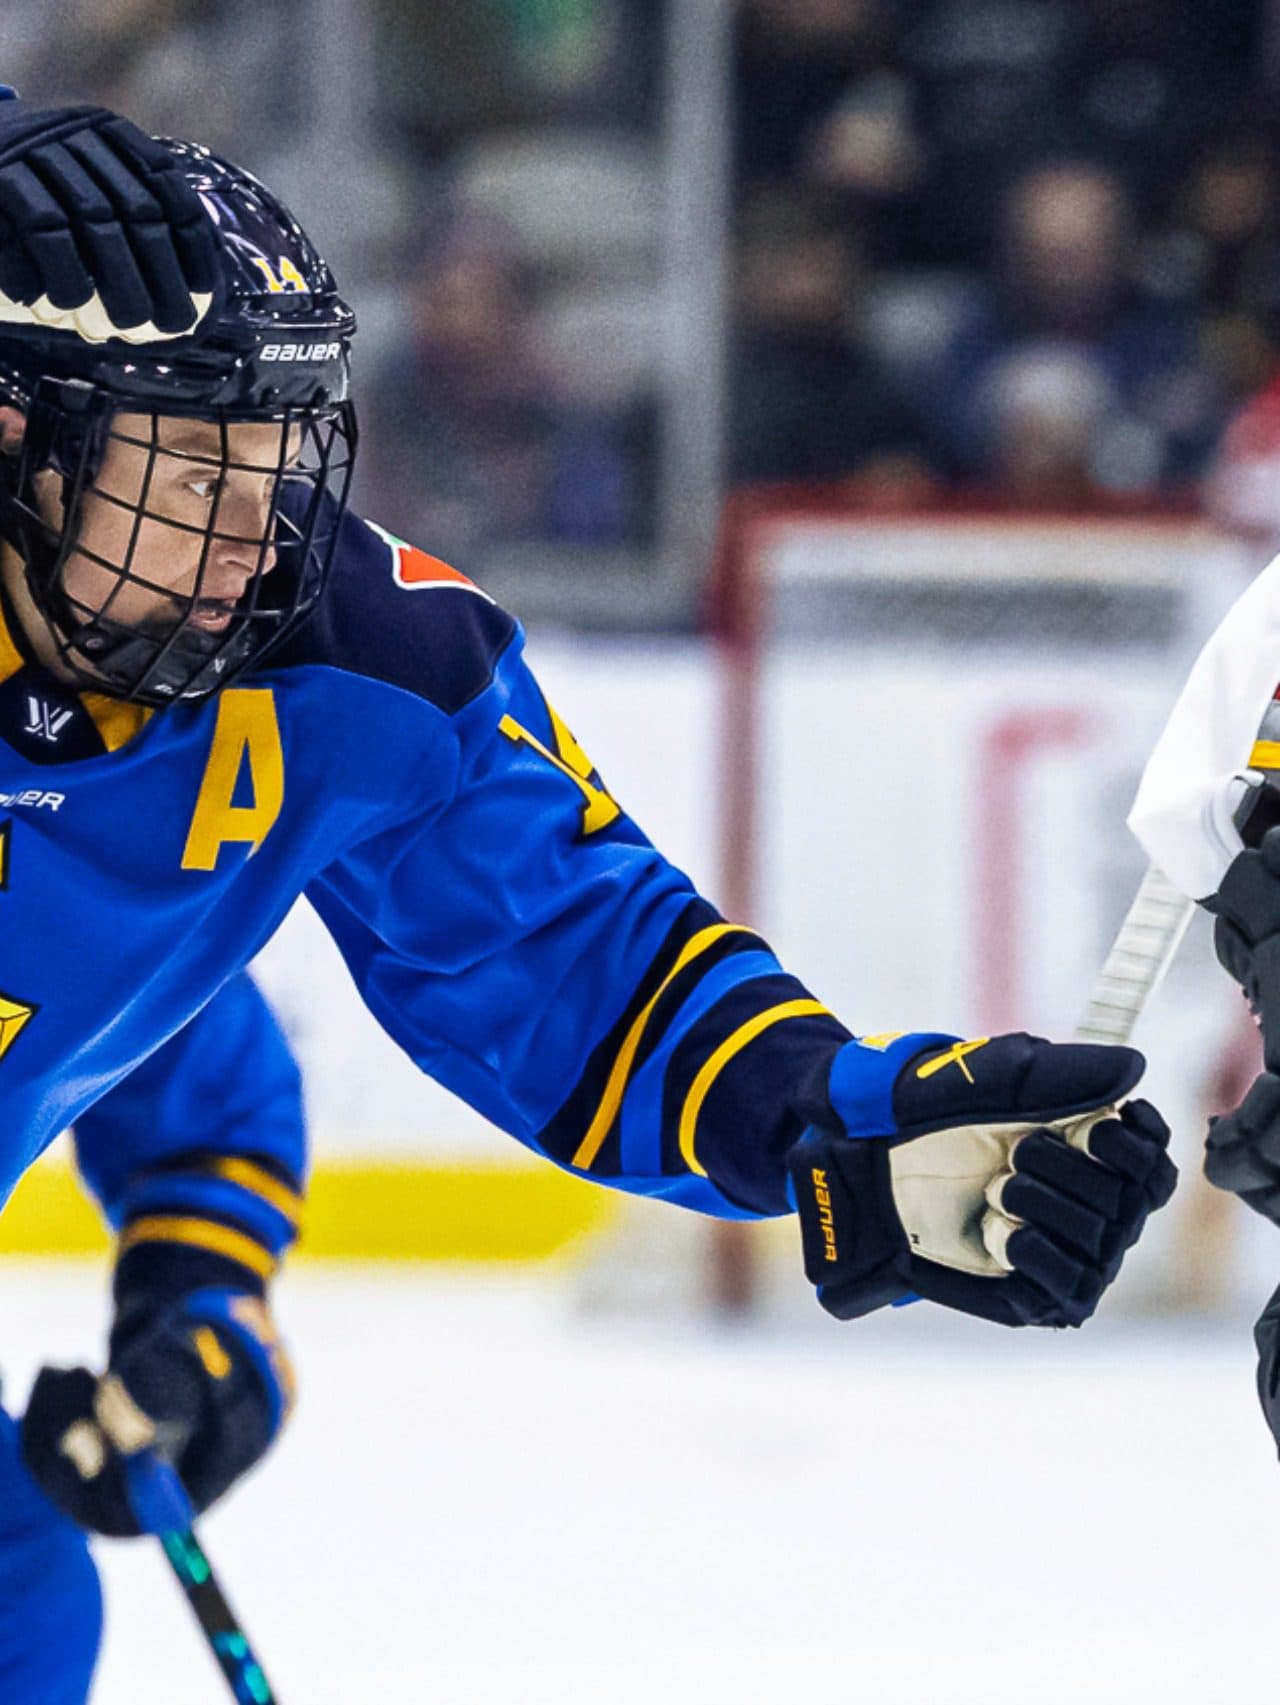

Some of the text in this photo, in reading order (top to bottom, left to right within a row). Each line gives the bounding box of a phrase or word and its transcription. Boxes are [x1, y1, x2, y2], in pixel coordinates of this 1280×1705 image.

[249, 255, 312, 294] 14
[259, 342, 341, 361] BAUER
[180, 688, 285, 871] A
[811, 1167, 838, 1262] BAUER
